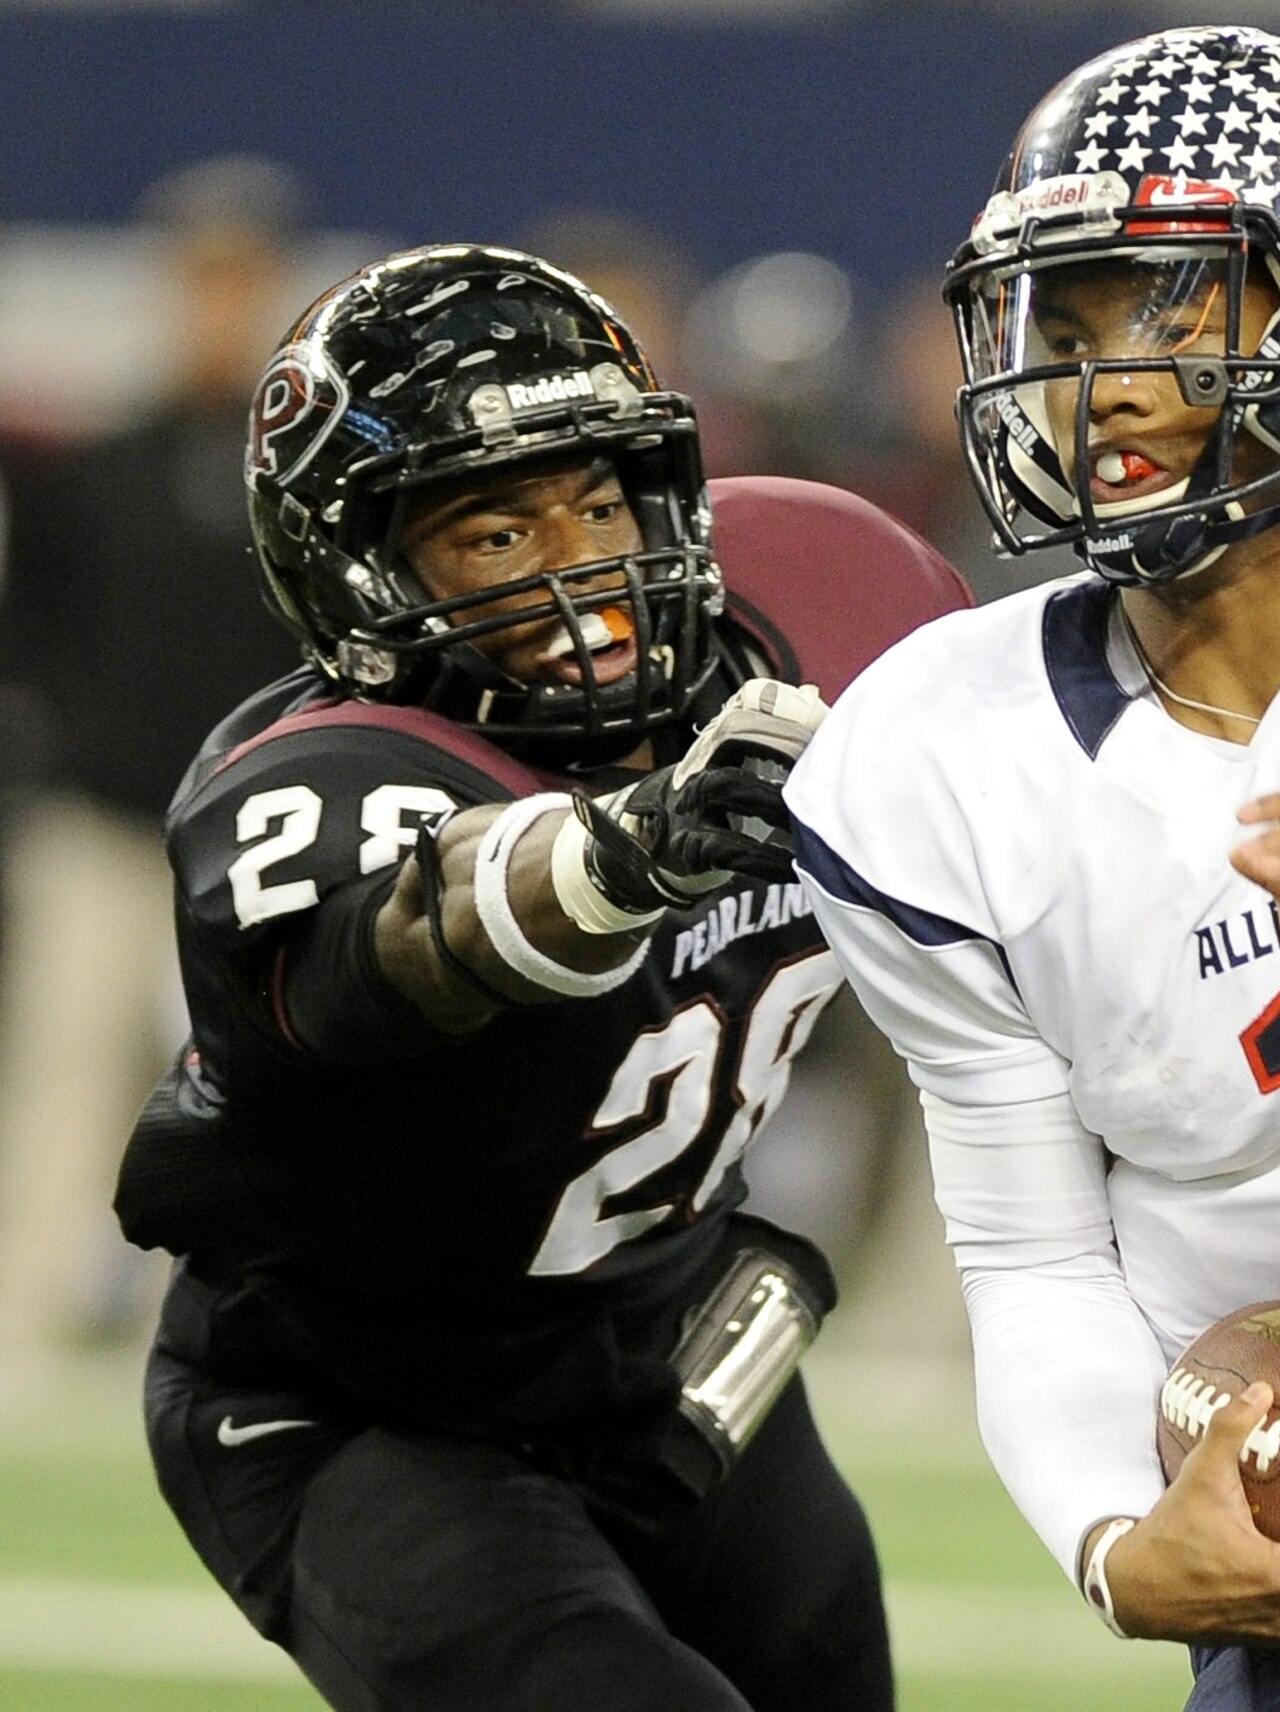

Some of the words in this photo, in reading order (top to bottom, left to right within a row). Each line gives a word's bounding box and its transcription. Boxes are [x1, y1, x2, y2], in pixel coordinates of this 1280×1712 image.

[246, 359, 315, 477] P
[506, 371, 594, 408] Riddell
[527, 944, 846, 1276] 28
